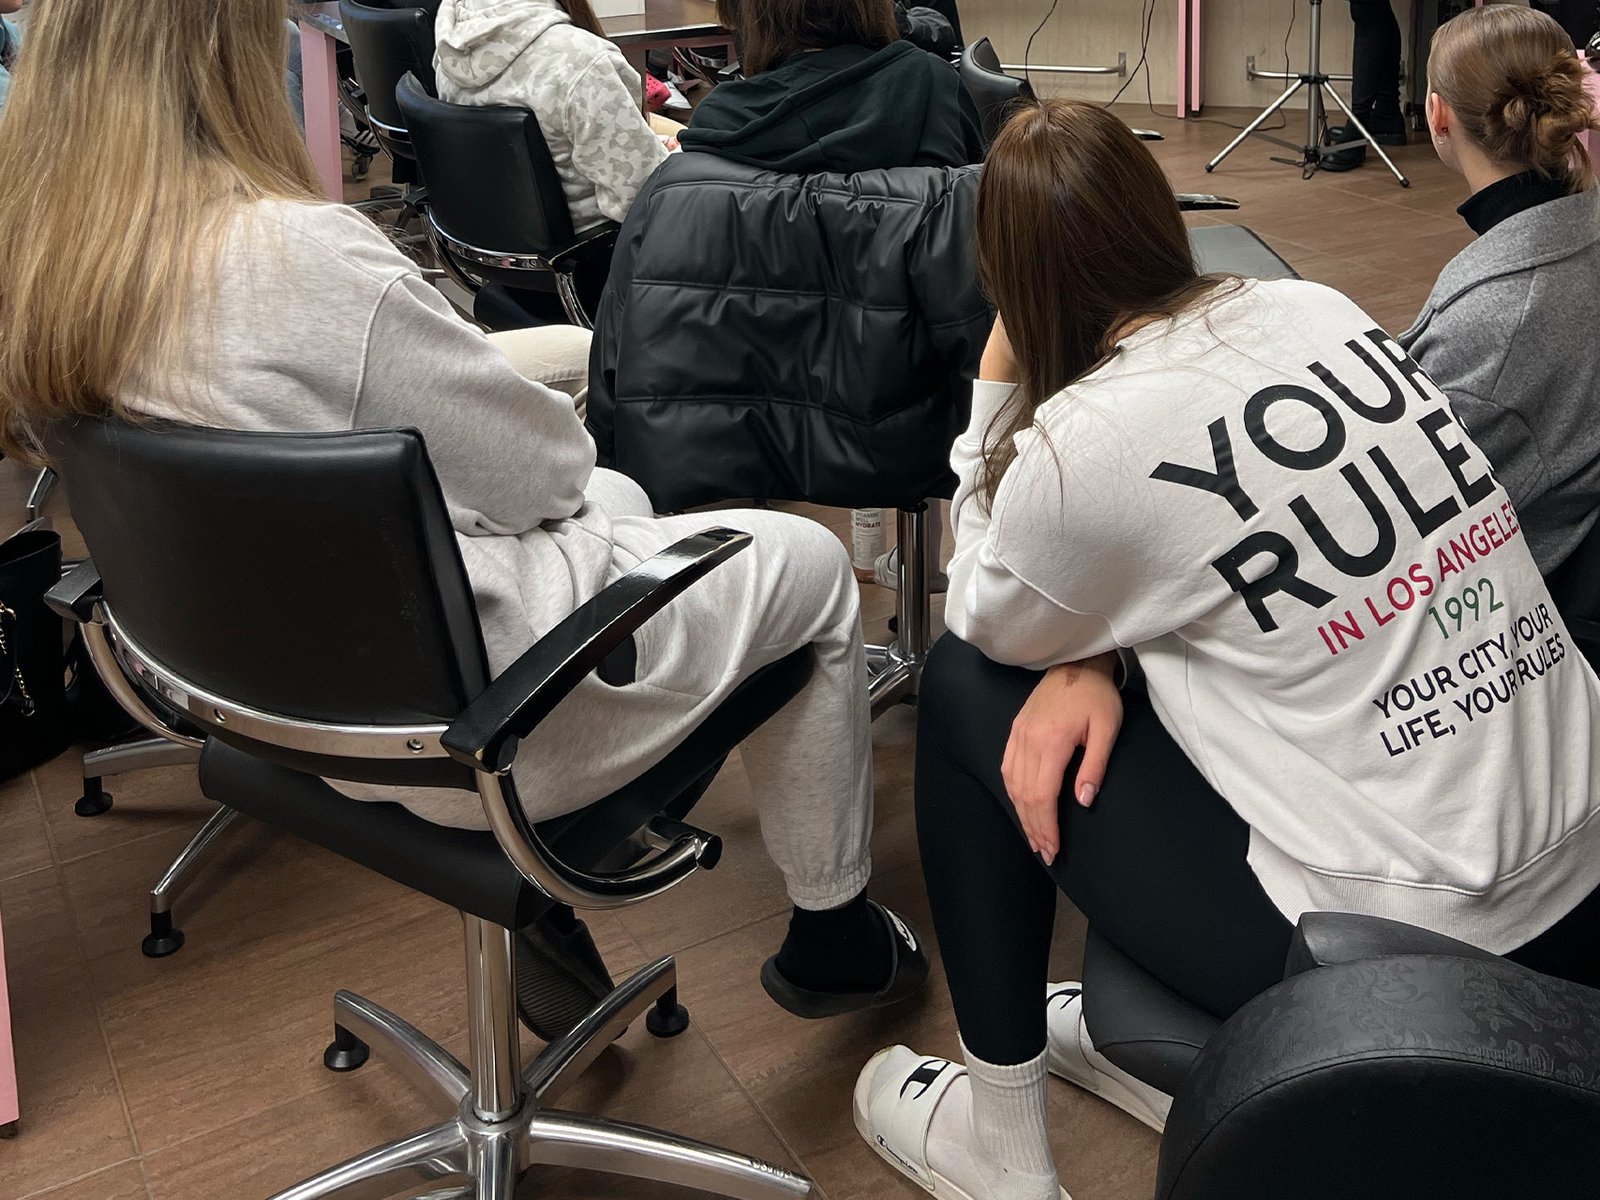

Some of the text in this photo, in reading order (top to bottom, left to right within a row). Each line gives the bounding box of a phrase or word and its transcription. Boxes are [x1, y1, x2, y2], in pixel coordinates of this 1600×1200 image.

[1149, 328, 1443, 522] YOUR
[1211, 403, 1497, 633] RULE
[1317, 611, 1366, 655] IN
[1365, 563, 1435, 627] LOS
[1372, 603, 1554, 719] YOUR CITY, YOUR
[1428, 578, 1504, 640] 1992
[1380, 633, 1566, 757] LIFE, YOUR RULES
